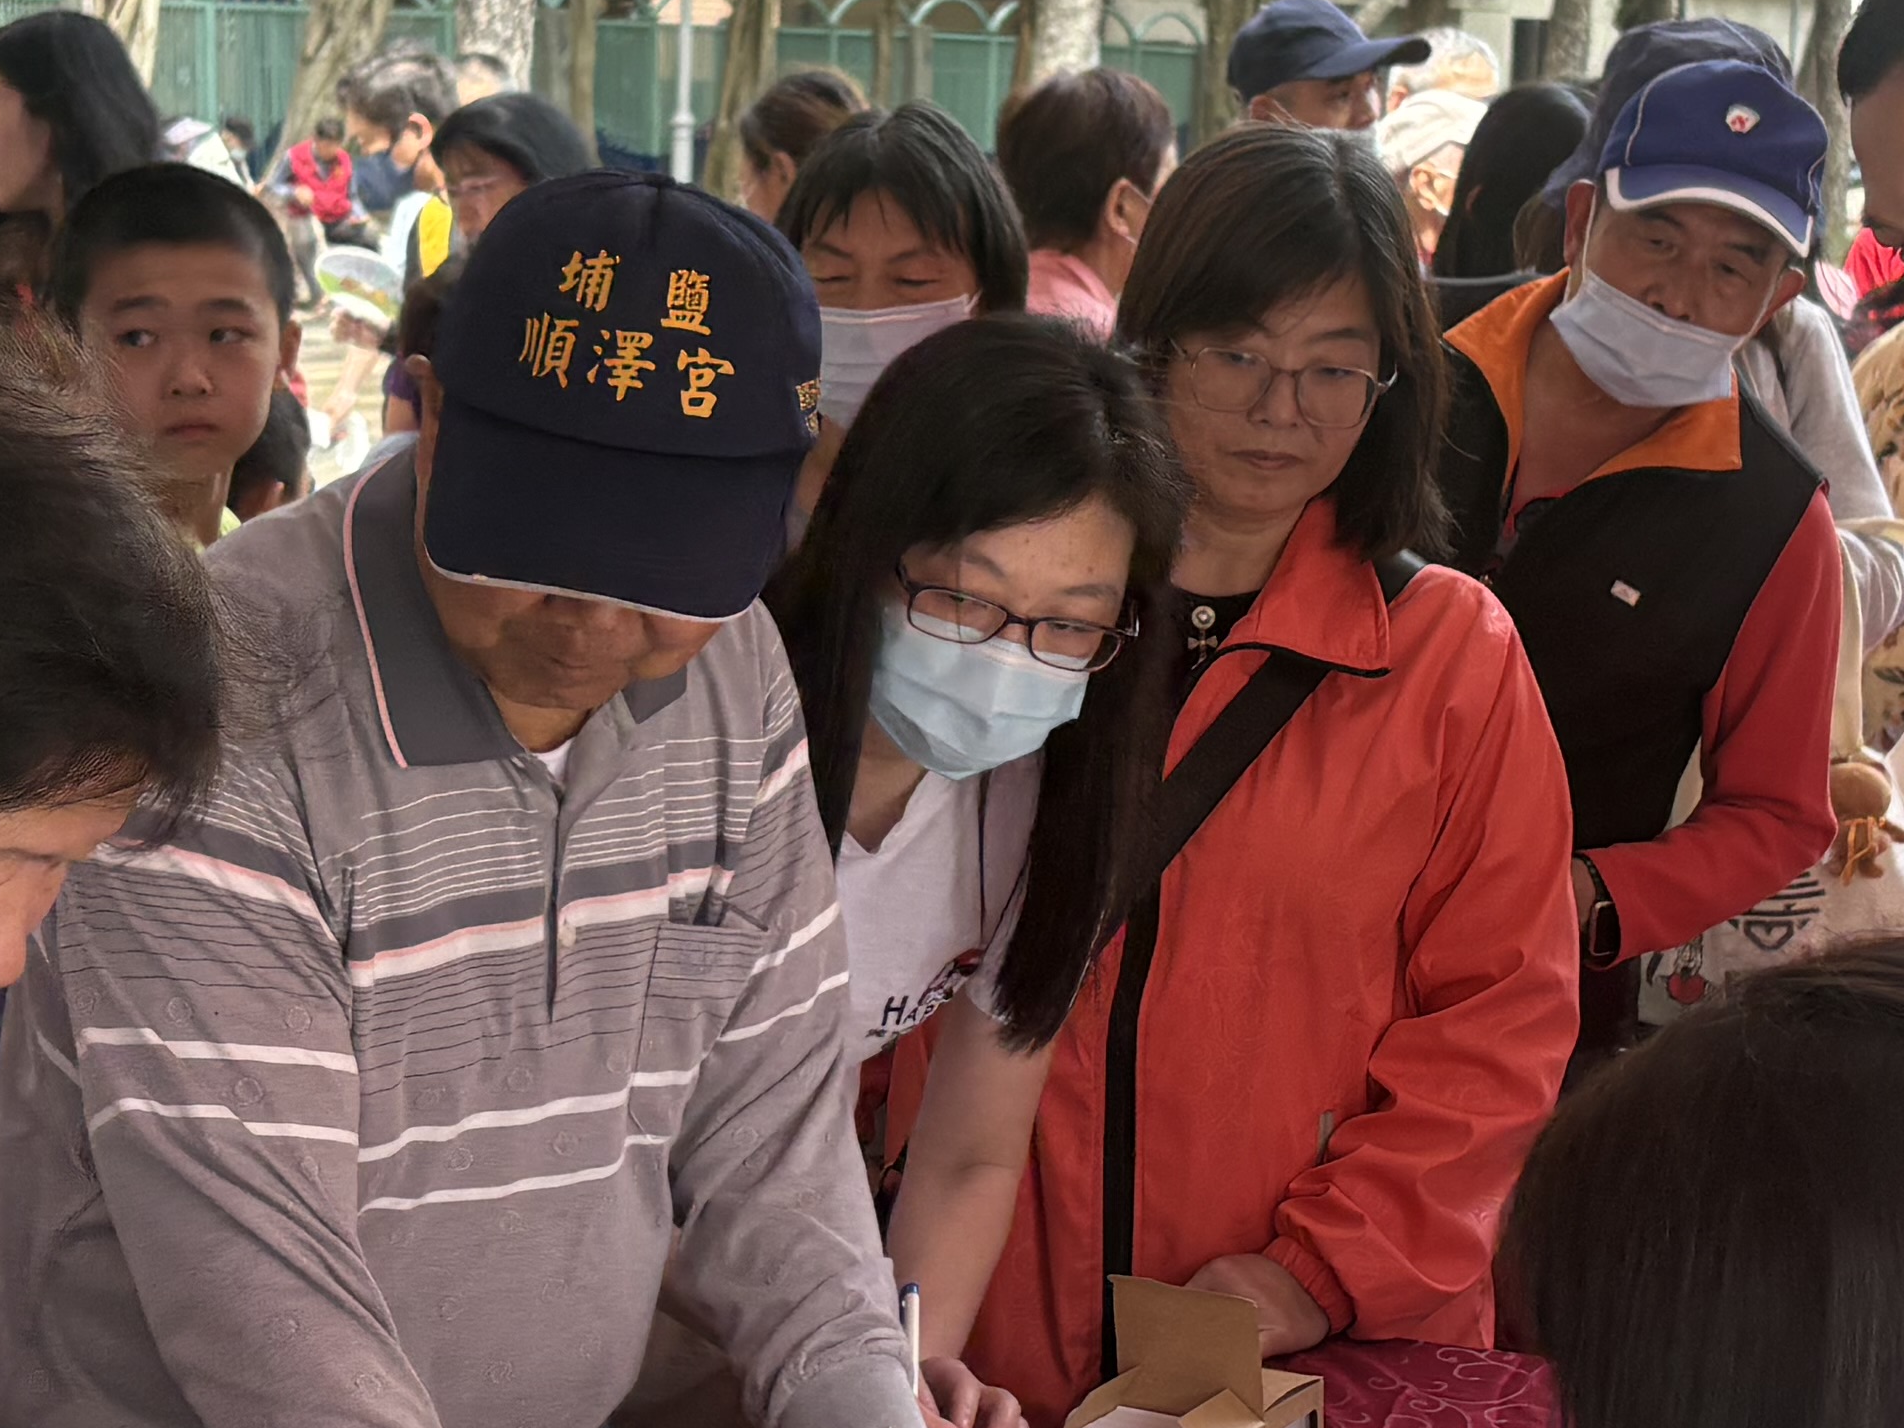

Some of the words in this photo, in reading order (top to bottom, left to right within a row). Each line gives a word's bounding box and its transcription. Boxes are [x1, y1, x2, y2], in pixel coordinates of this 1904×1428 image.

[558, 249, 712, 336] 埔鹽
[519, 312, 736, 418] 順澤宮
